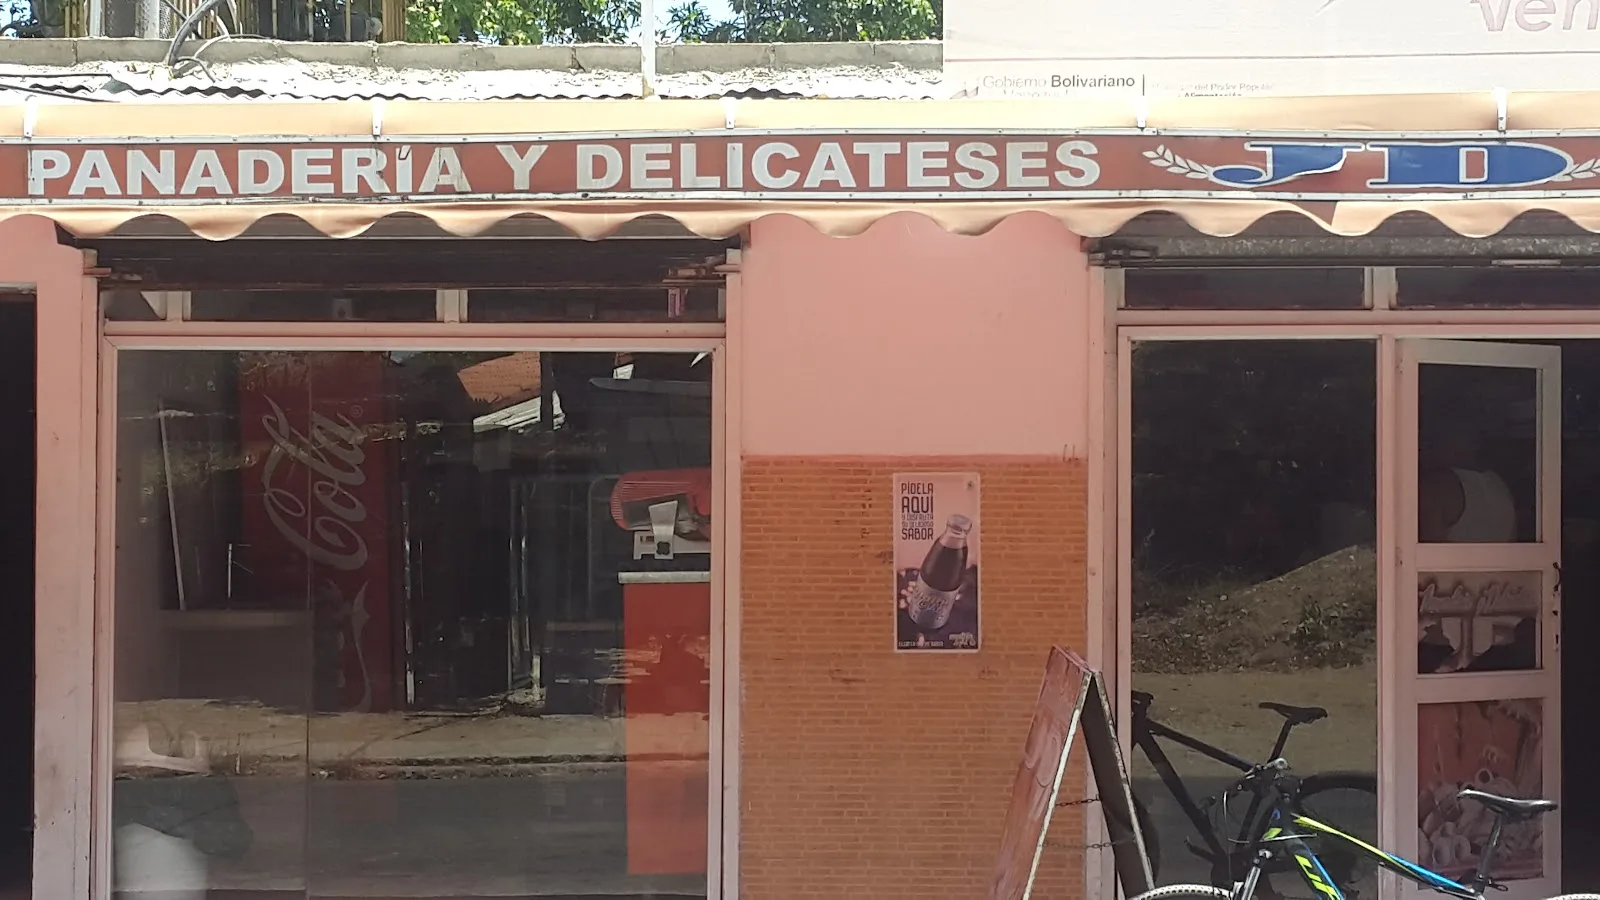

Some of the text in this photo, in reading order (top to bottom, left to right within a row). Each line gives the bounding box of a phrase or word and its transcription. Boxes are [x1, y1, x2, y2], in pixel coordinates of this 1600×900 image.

[983, 74, 1135, 88] Gobierno Bolivariano
[27, 141, 1101, 196] PANADERÍA Y DELICATESES
[262, 394, 368, 571] Cola
[901, 528, 934, 541] SABOR
